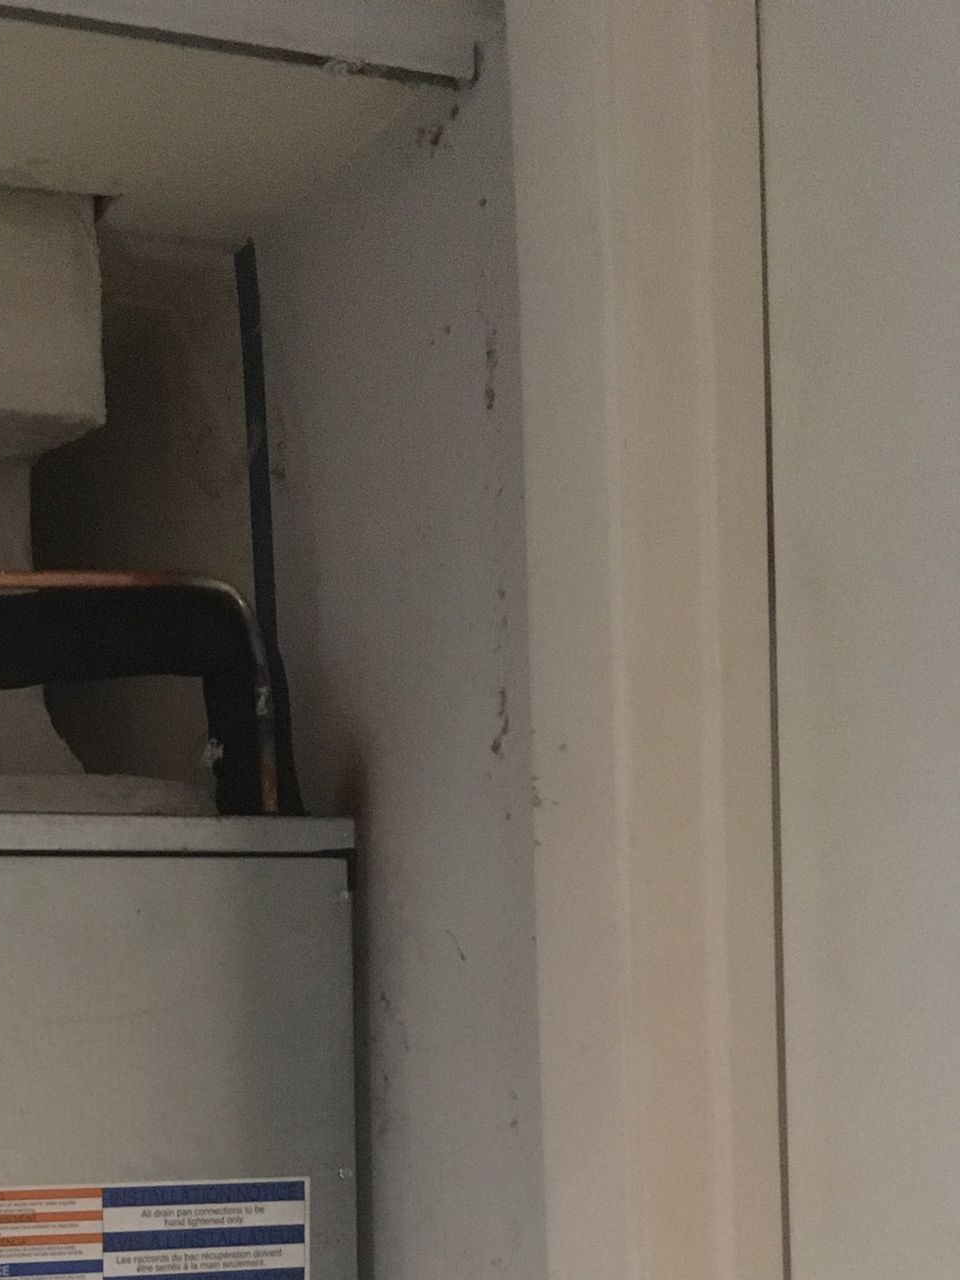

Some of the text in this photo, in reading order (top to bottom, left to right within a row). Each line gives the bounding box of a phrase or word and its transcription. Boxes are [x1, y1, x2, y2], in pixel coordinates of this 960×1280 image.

[154, 1208, 175, 1218] drain
[177, 1208, 192, 1219] pan
[194, 1206, 243, 1217] connections
[245, 1206, 253, 1214] to
[187, 1215, 225, 1227] tightened
[116, 1256, 131, 1265] Les
[133, 1254, 169, 1264] raccords
[171, 1252, 182, 1262] du
[253, 1248, 282, 1258] doivent
[200, 1260, 220, 1269] main
